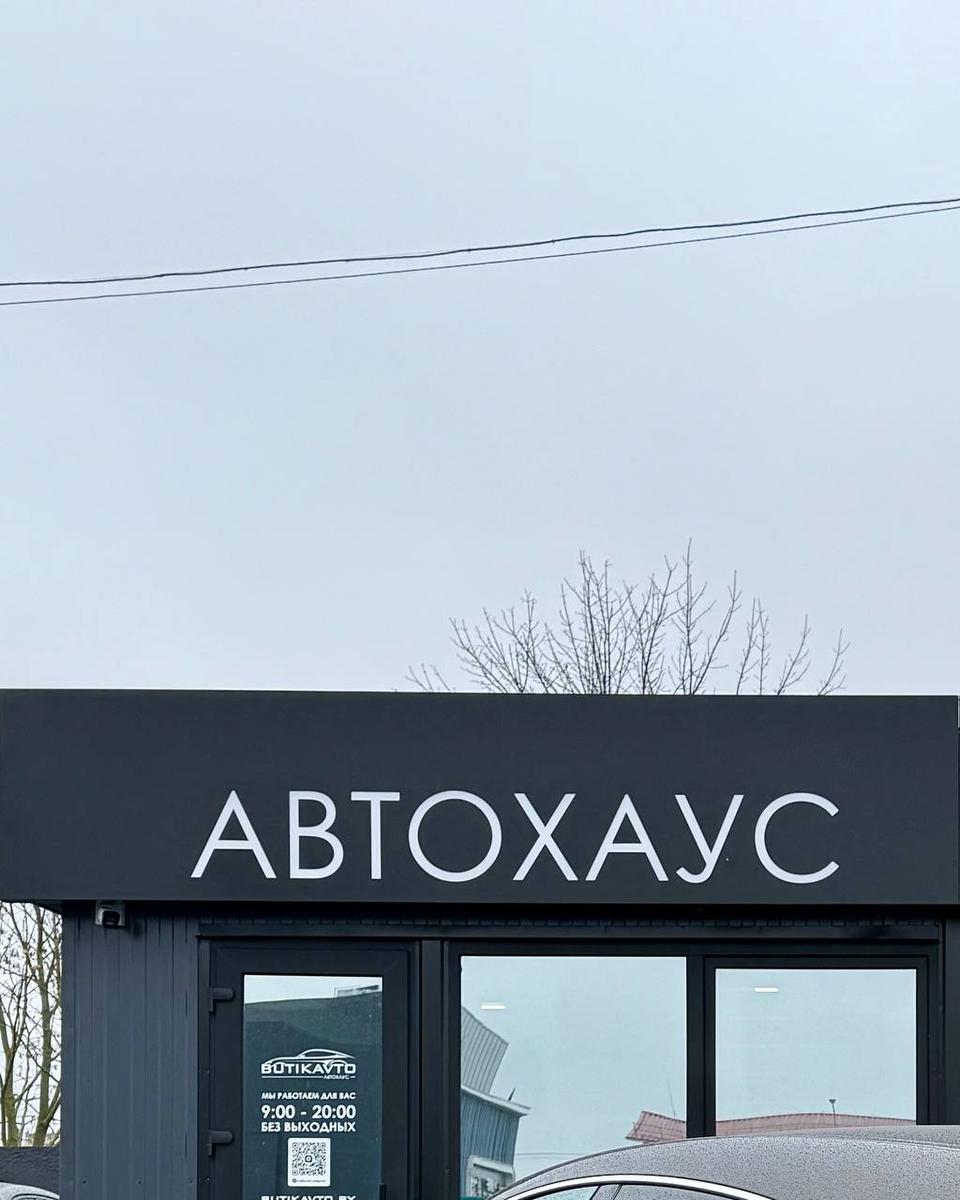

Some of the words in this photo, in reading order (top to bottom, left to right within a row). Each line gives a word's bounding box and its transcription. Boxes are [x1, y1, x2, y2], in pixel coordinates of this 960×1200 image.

[191, 790, 839, 884] АВТОХАУС
[261, 1062, 356, 1074] BUTIKAVTO
[261, 1092, 276, 1100] МЫ
[277, 1092, 320, 1100] РАБОТАЕМ
[320, 1092, 338, 1100] ДЛЯ
[339, 1092, 356, 1100] ВАС
[261, 1104, 295, 1119] 9:00
[312, 1104, 356, 1119] 20:00
[261, 1121, 281, 1132] БЕЗ
[284, 1121, 356, 1133] ВЫХОДНЫХ
